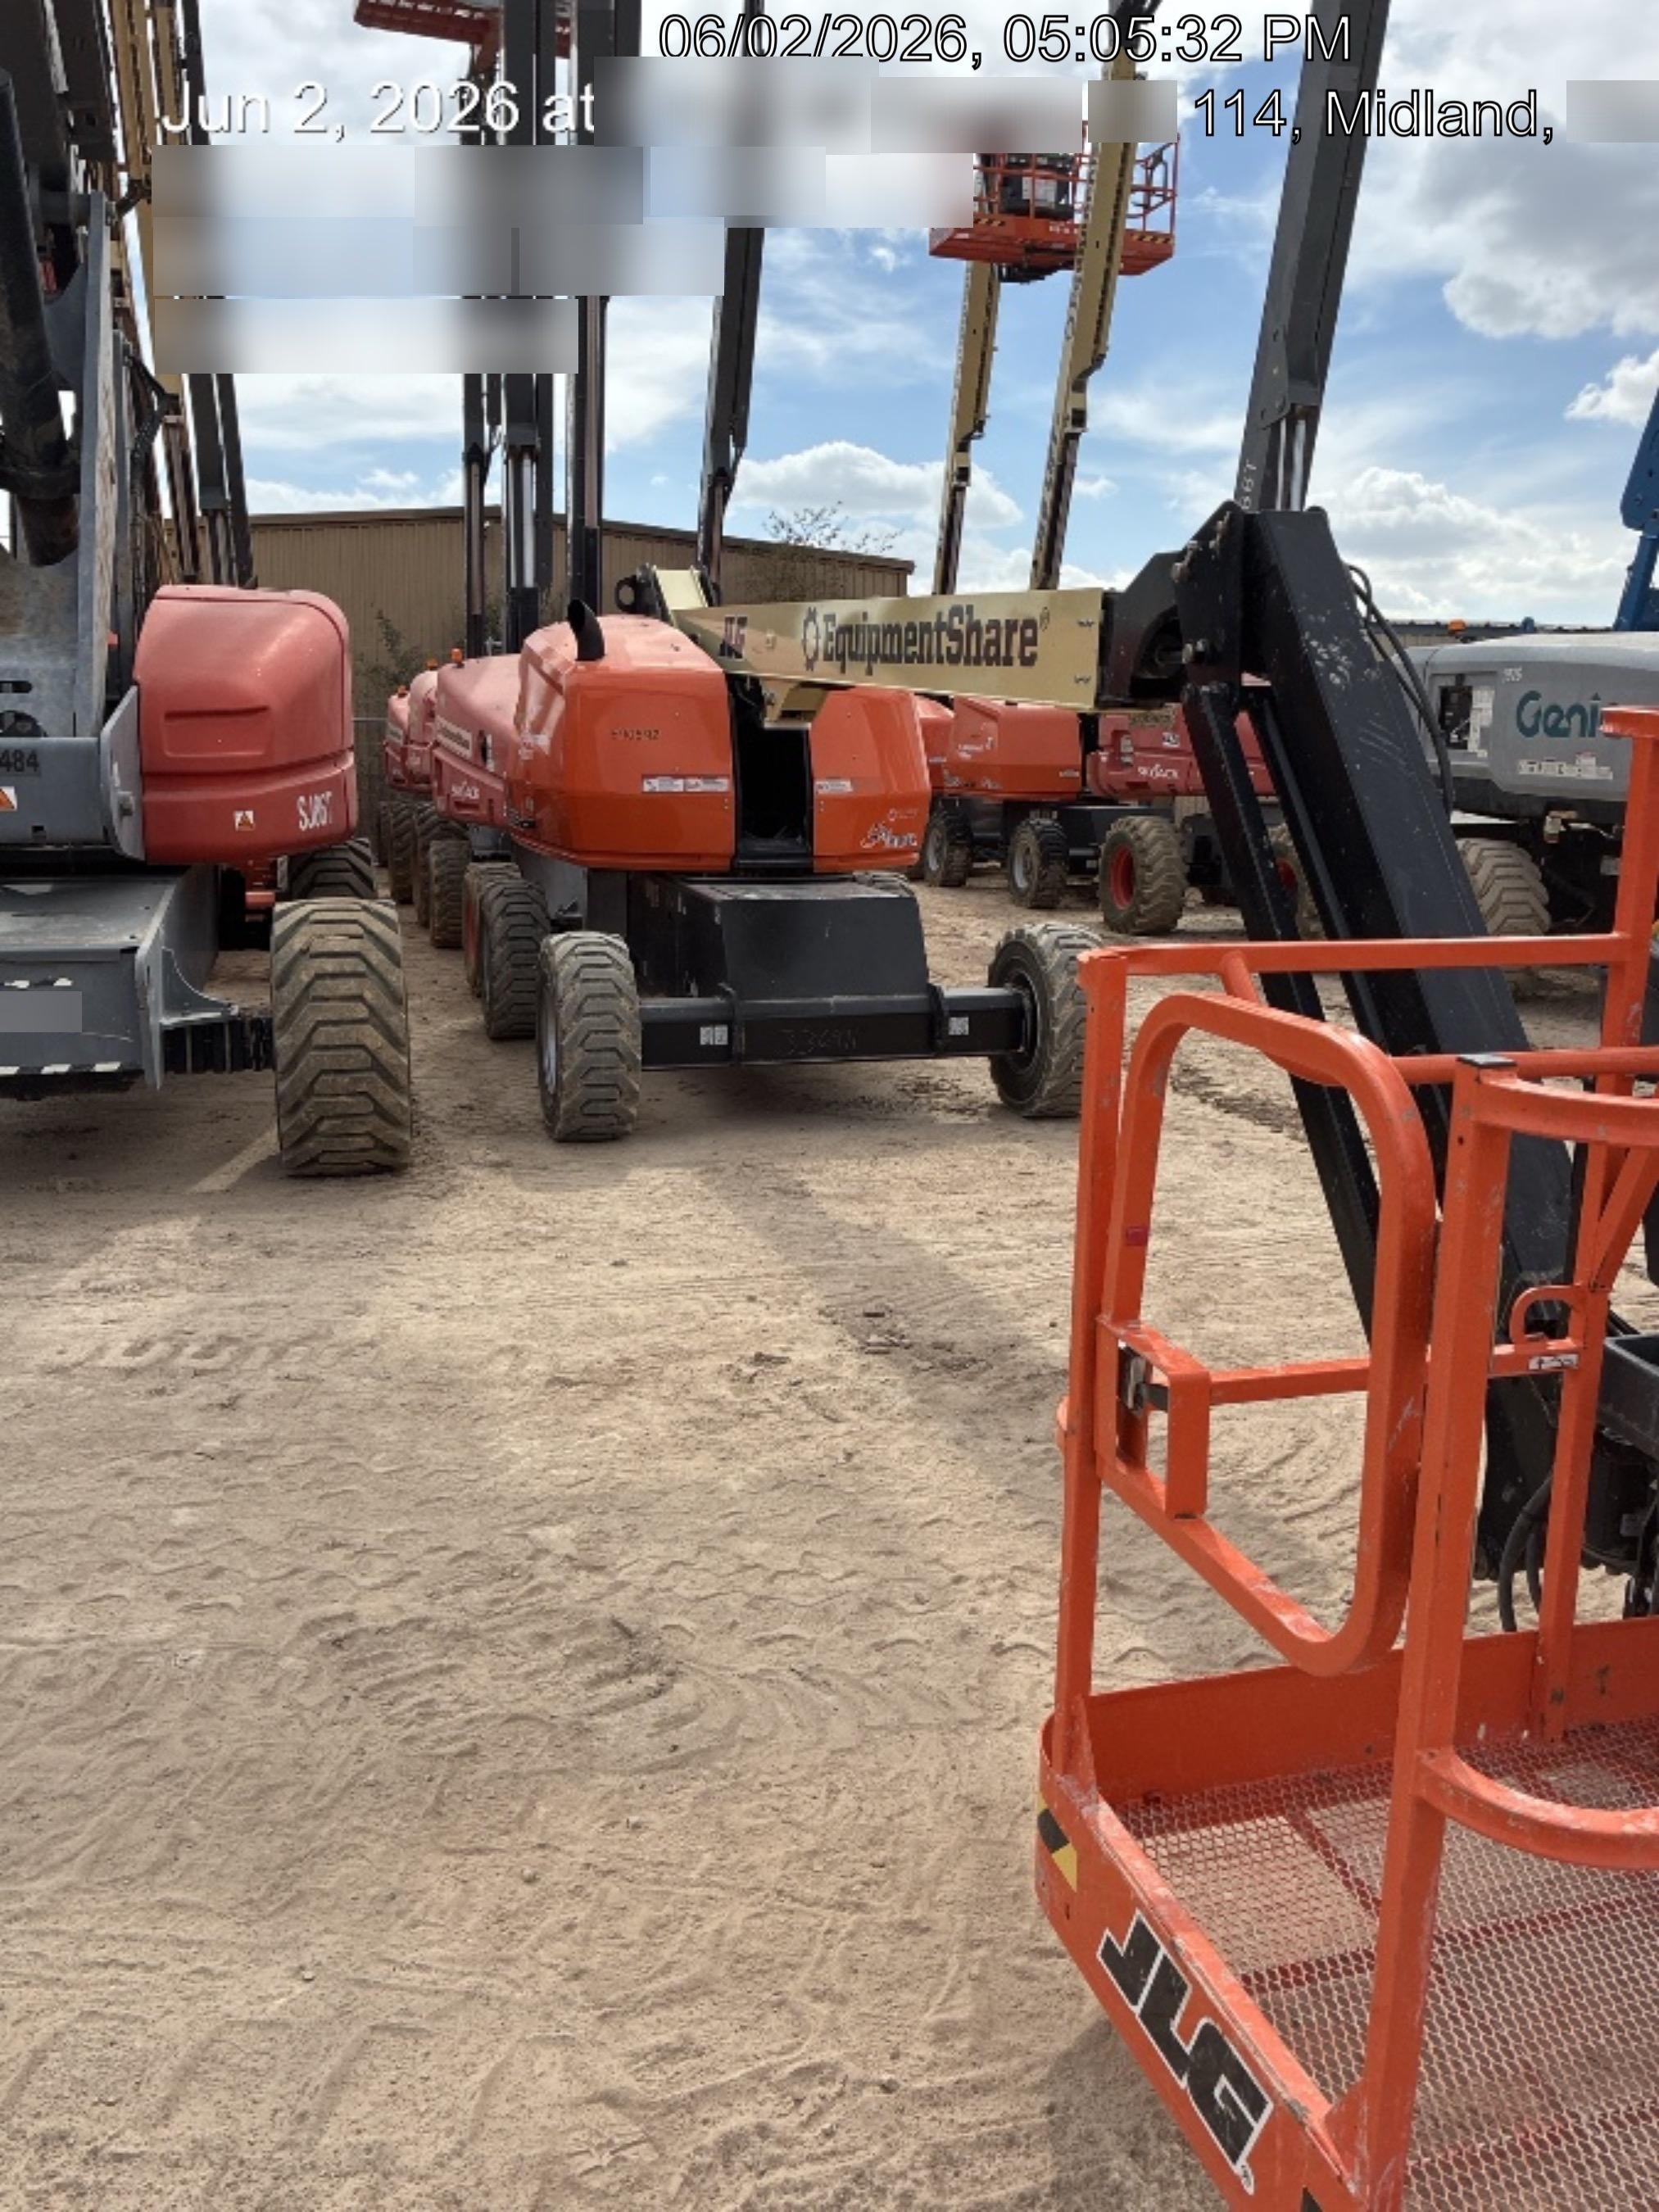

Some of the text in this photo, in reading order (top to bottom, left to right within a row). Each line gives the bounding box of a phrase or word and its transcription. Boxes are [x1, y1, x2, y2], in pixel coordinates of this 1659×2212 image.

[823, 604, 1038, 676] EquipmentShare
[1517, 690, 1601, 738] Geni
[1097, 1907, 1275, 2175] JLG
